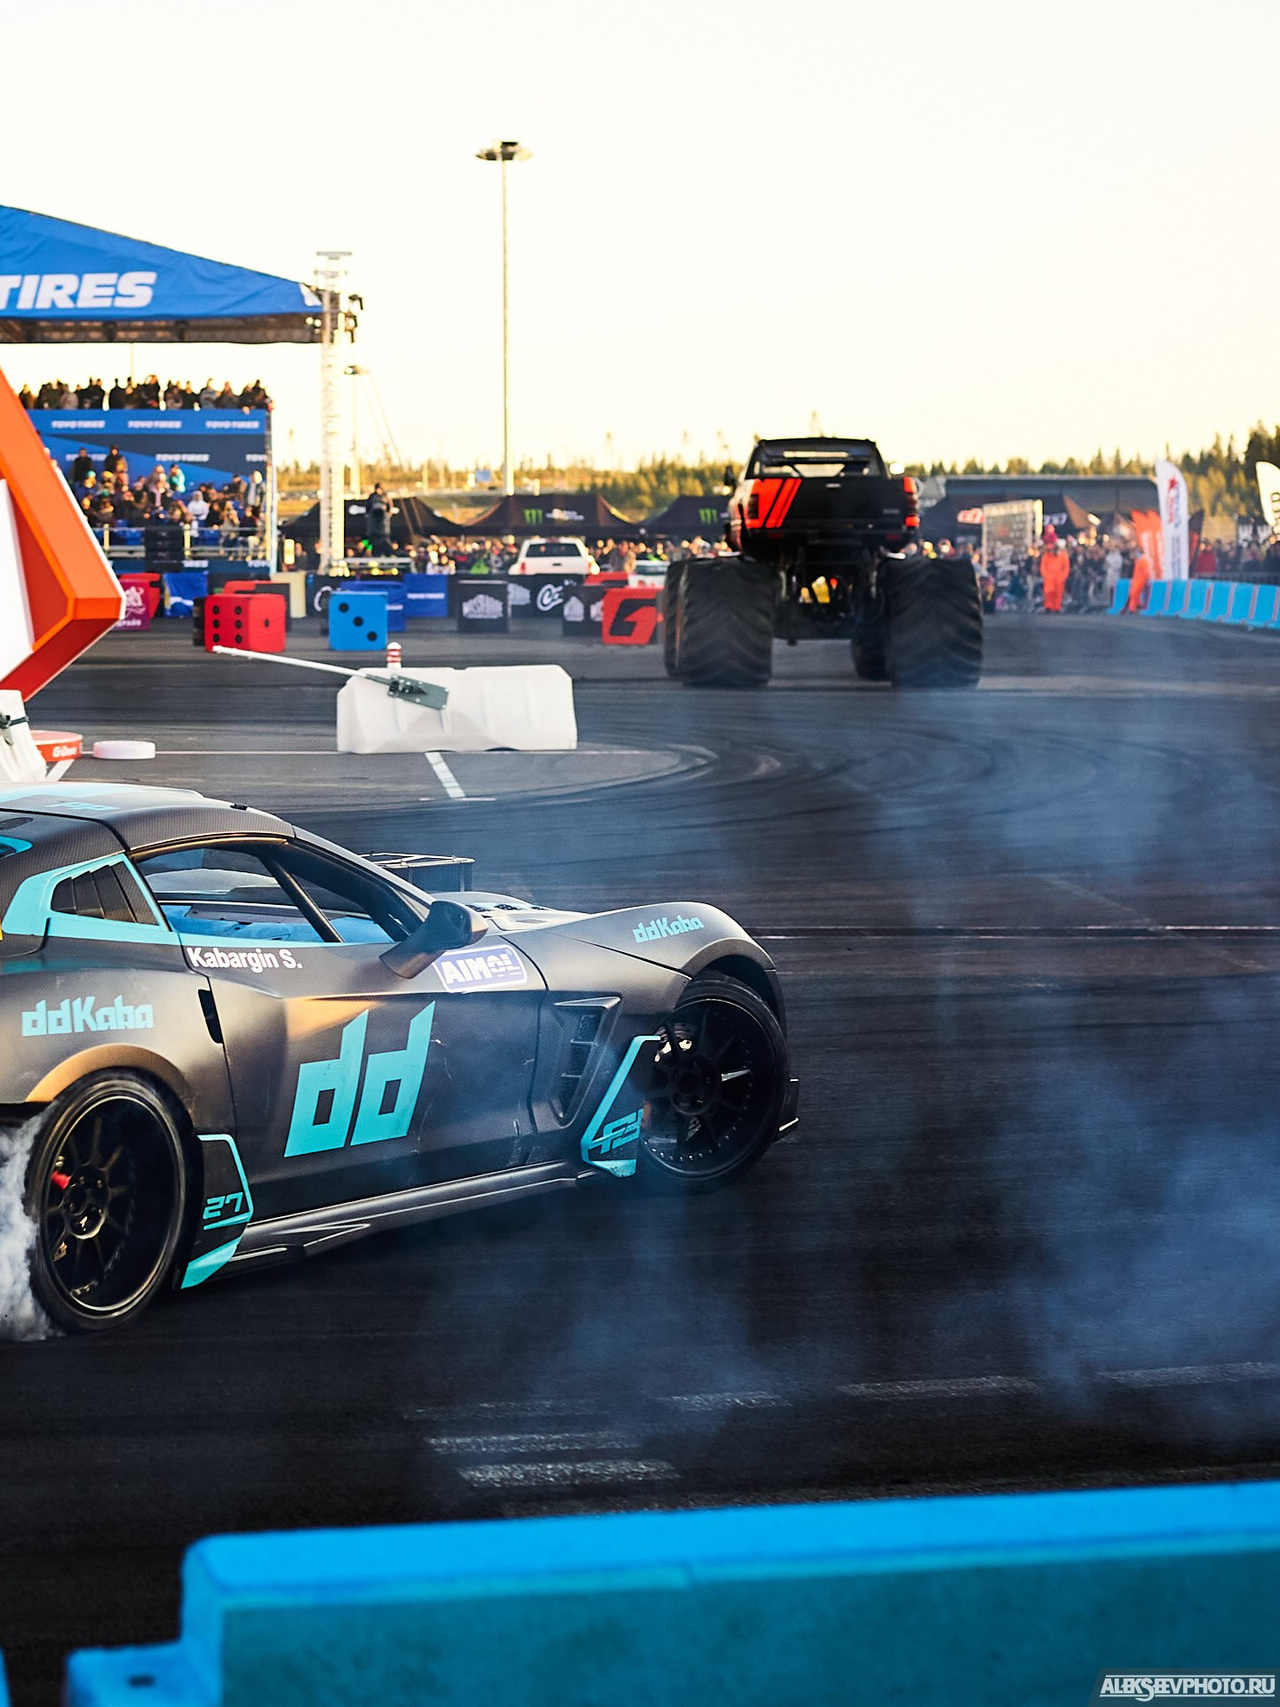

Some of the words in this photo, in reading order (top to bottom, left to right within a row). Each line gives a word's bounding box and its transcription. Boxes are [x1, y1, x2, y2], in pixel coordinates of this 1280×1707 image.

[632, 914, 705, 943] ddKaba
[186, 947, 279, 974] Kabargin
[279, 948, 303, 969] S.
[21, 994, 155, 1037] ddKaba
[283, 1000, 436, 1159] dd
[202, 1192, 244, 1220] 27
